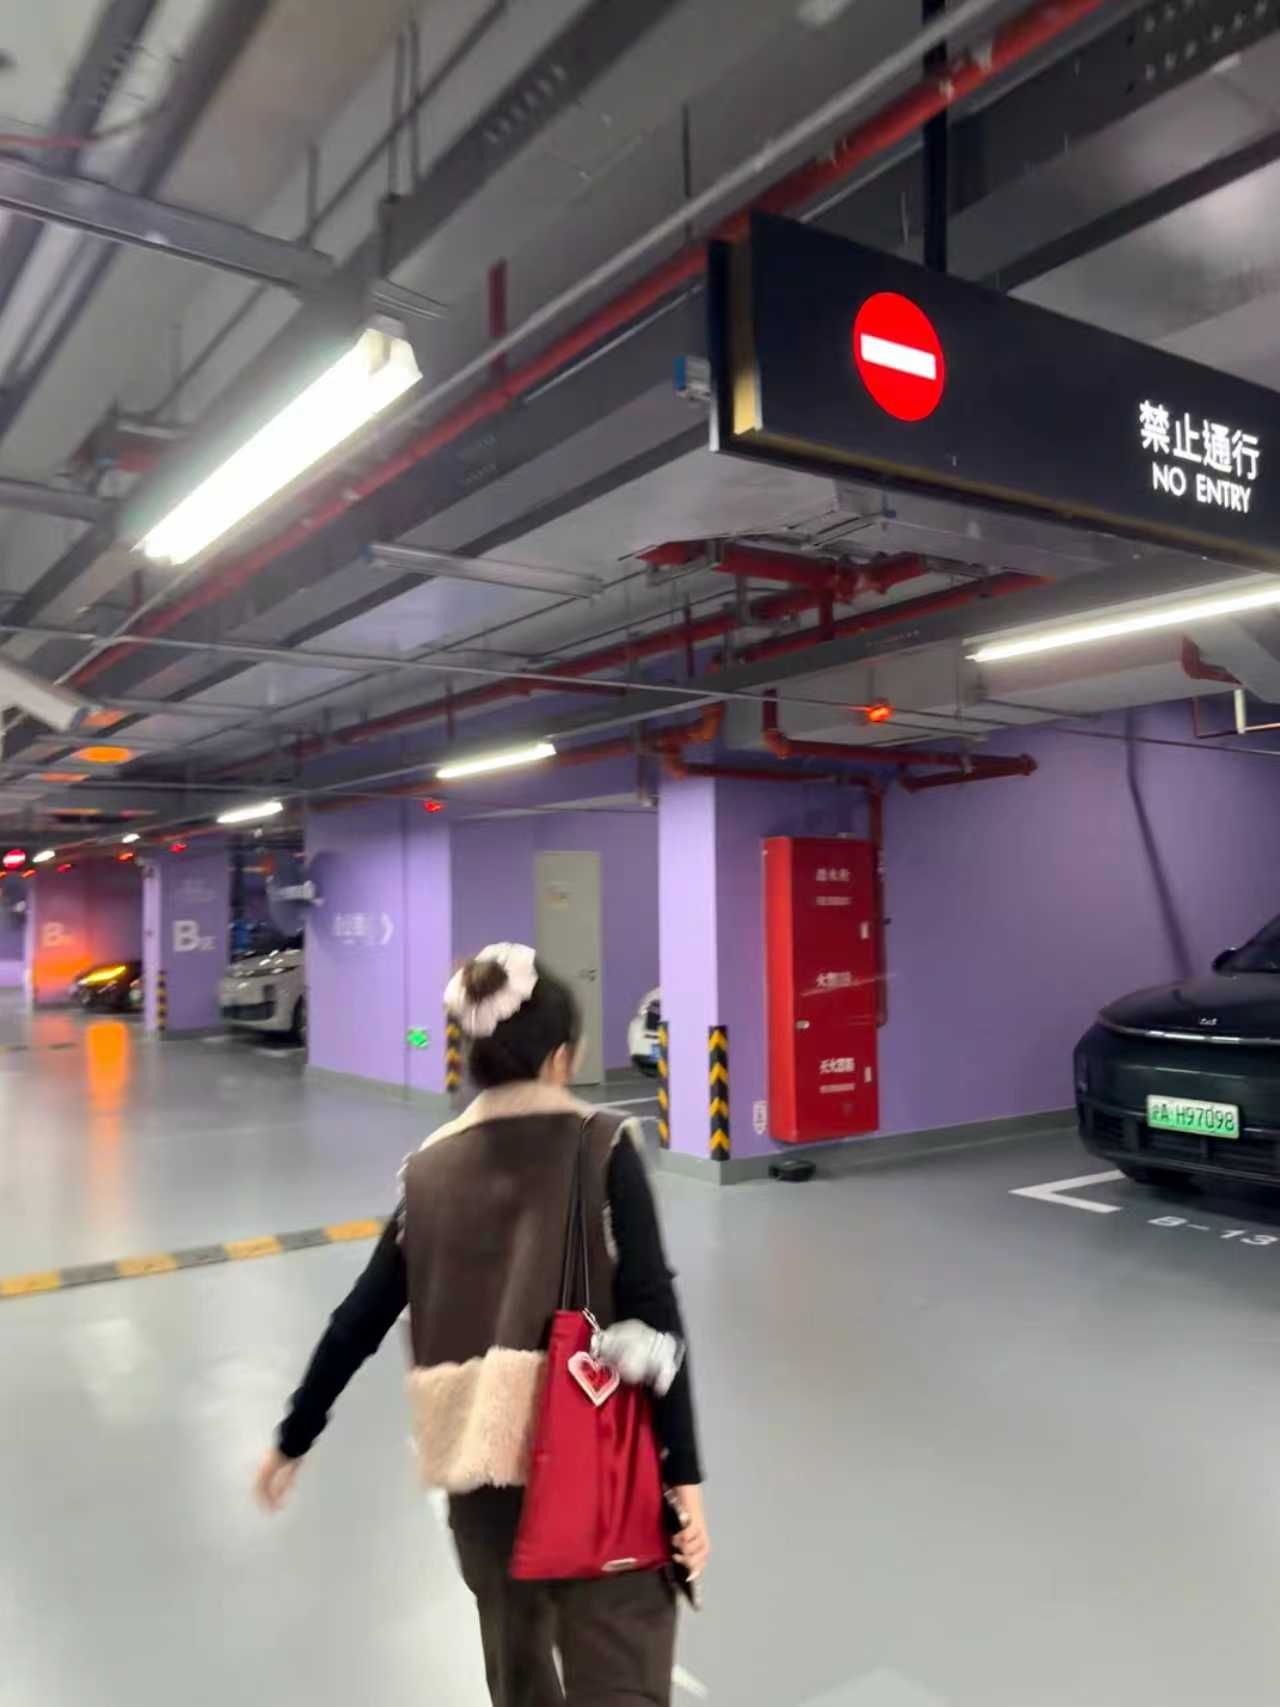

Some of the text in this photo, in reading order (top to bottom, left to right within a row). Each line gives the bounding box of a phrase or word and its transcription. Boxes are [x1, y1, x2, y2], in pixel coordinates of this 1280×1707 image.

[1139, 400, 1260, 480] 禁止通行
[1152, 462, 1251, 513] NO ENTRY
